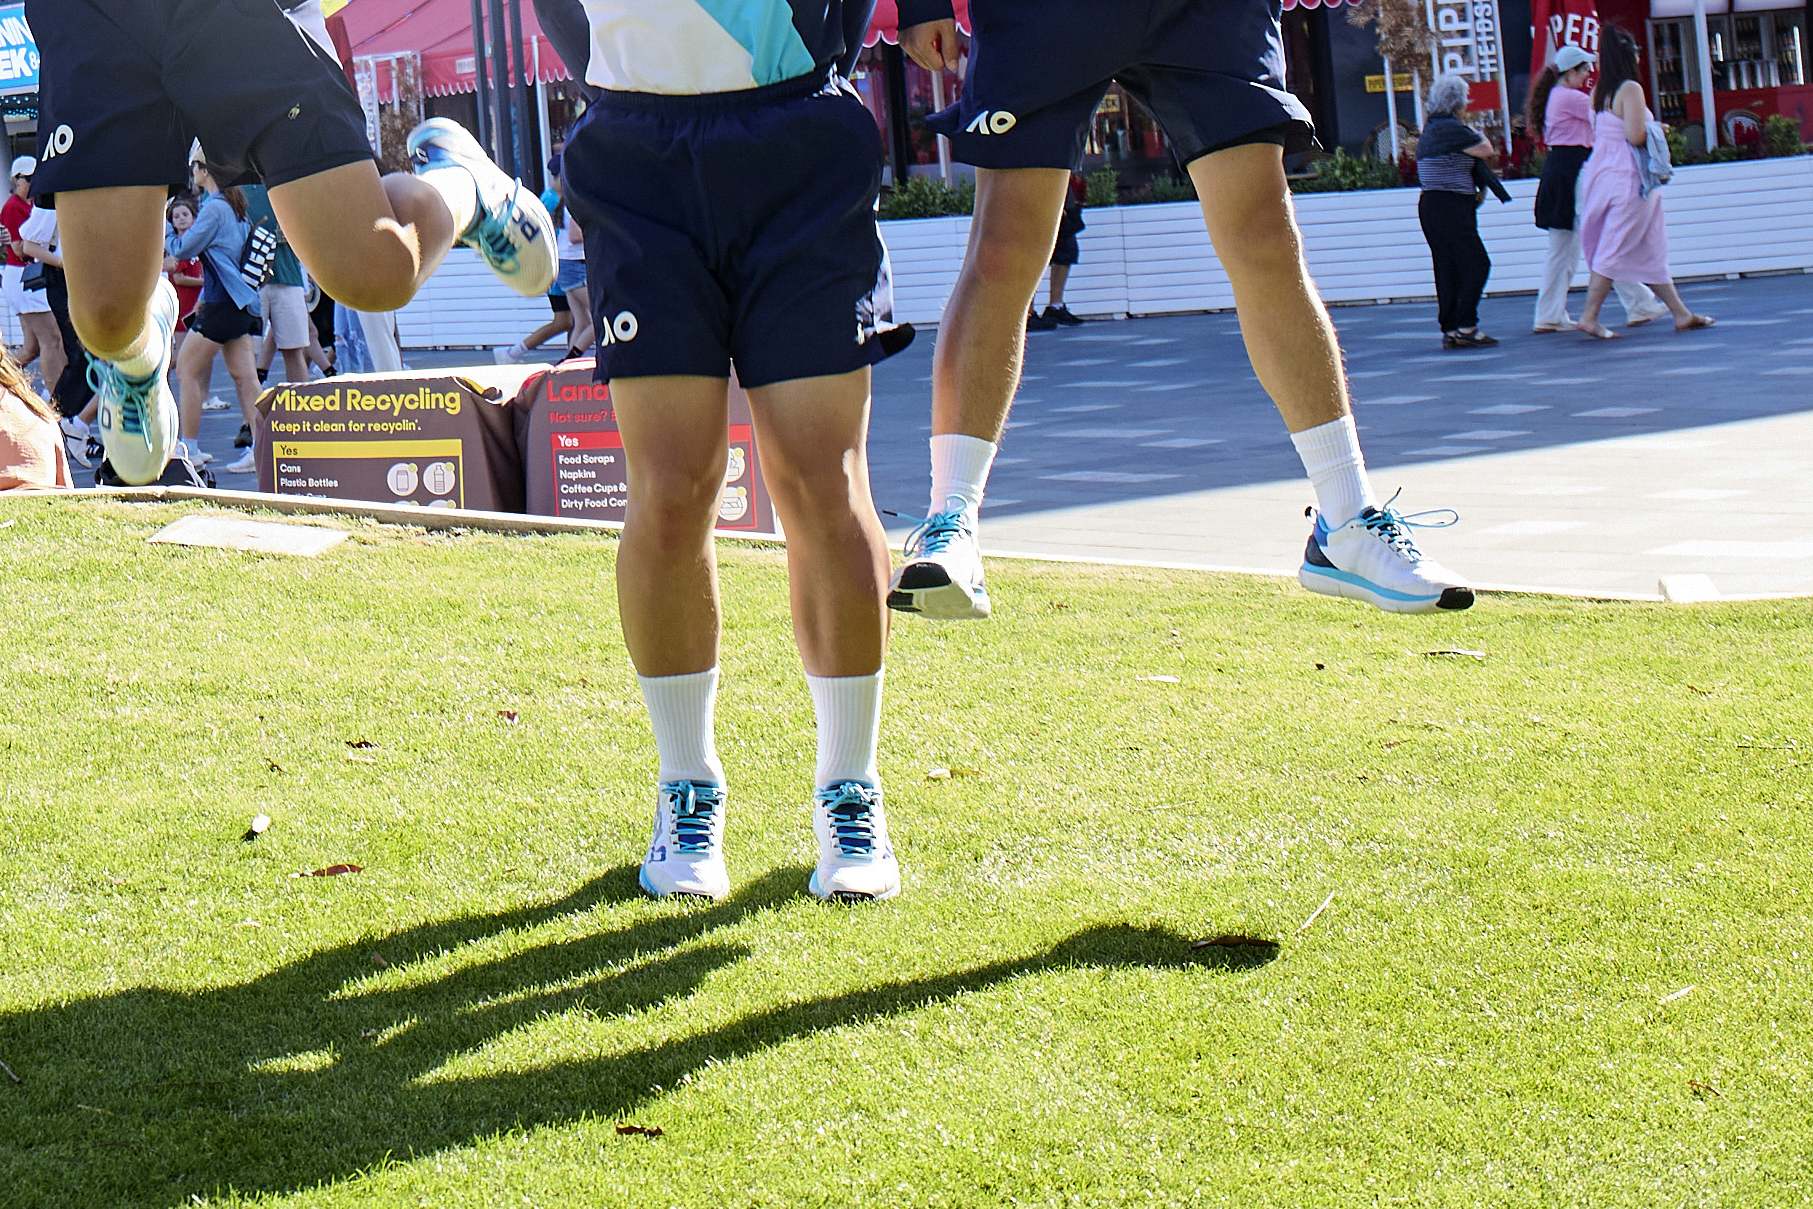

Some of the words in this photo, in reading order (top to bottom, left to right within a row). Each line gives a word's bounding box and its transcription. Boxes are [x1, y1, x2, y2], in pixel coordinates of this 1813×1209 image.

[1549, 12, 1600, 52] PER
[965, 110, 1017, 136] AO
[41, 124, 73, 163] AO
[602, 311, 638, 347] AO
[271, 388, 340, 412] Mixed
[346, 387, 462, 417] Recycling
[549, 411, 571, 423] Not
[573, 410, 607, 422] sure?
[271, 420, 300, 434] Keep
[302, 421, 311, 432] it
[313, 420, 346, 432] clean
[348, 420, 366, 432] for
[558, 435, 579, 447] Yes
[280, 445, 298, 456] Yes
[558, 454, 581, 465] Food
[582, 454, 615, 465] Scraps
[280, 463, 301, 473] Cans
[559, 469, 596, 481] Napkins
[280, 478, 307, 488] Plastic
[308, 477, 338, 488] Bottles
[560, 483, 593, 494] Coffee
[593, 483, 619, 495] Cups
[619, 483, 627, 493] &
[561, 498, 584, 511] Dirty
[584, 498, 608, 509] Food
[609, 497, 628, 508] Con
